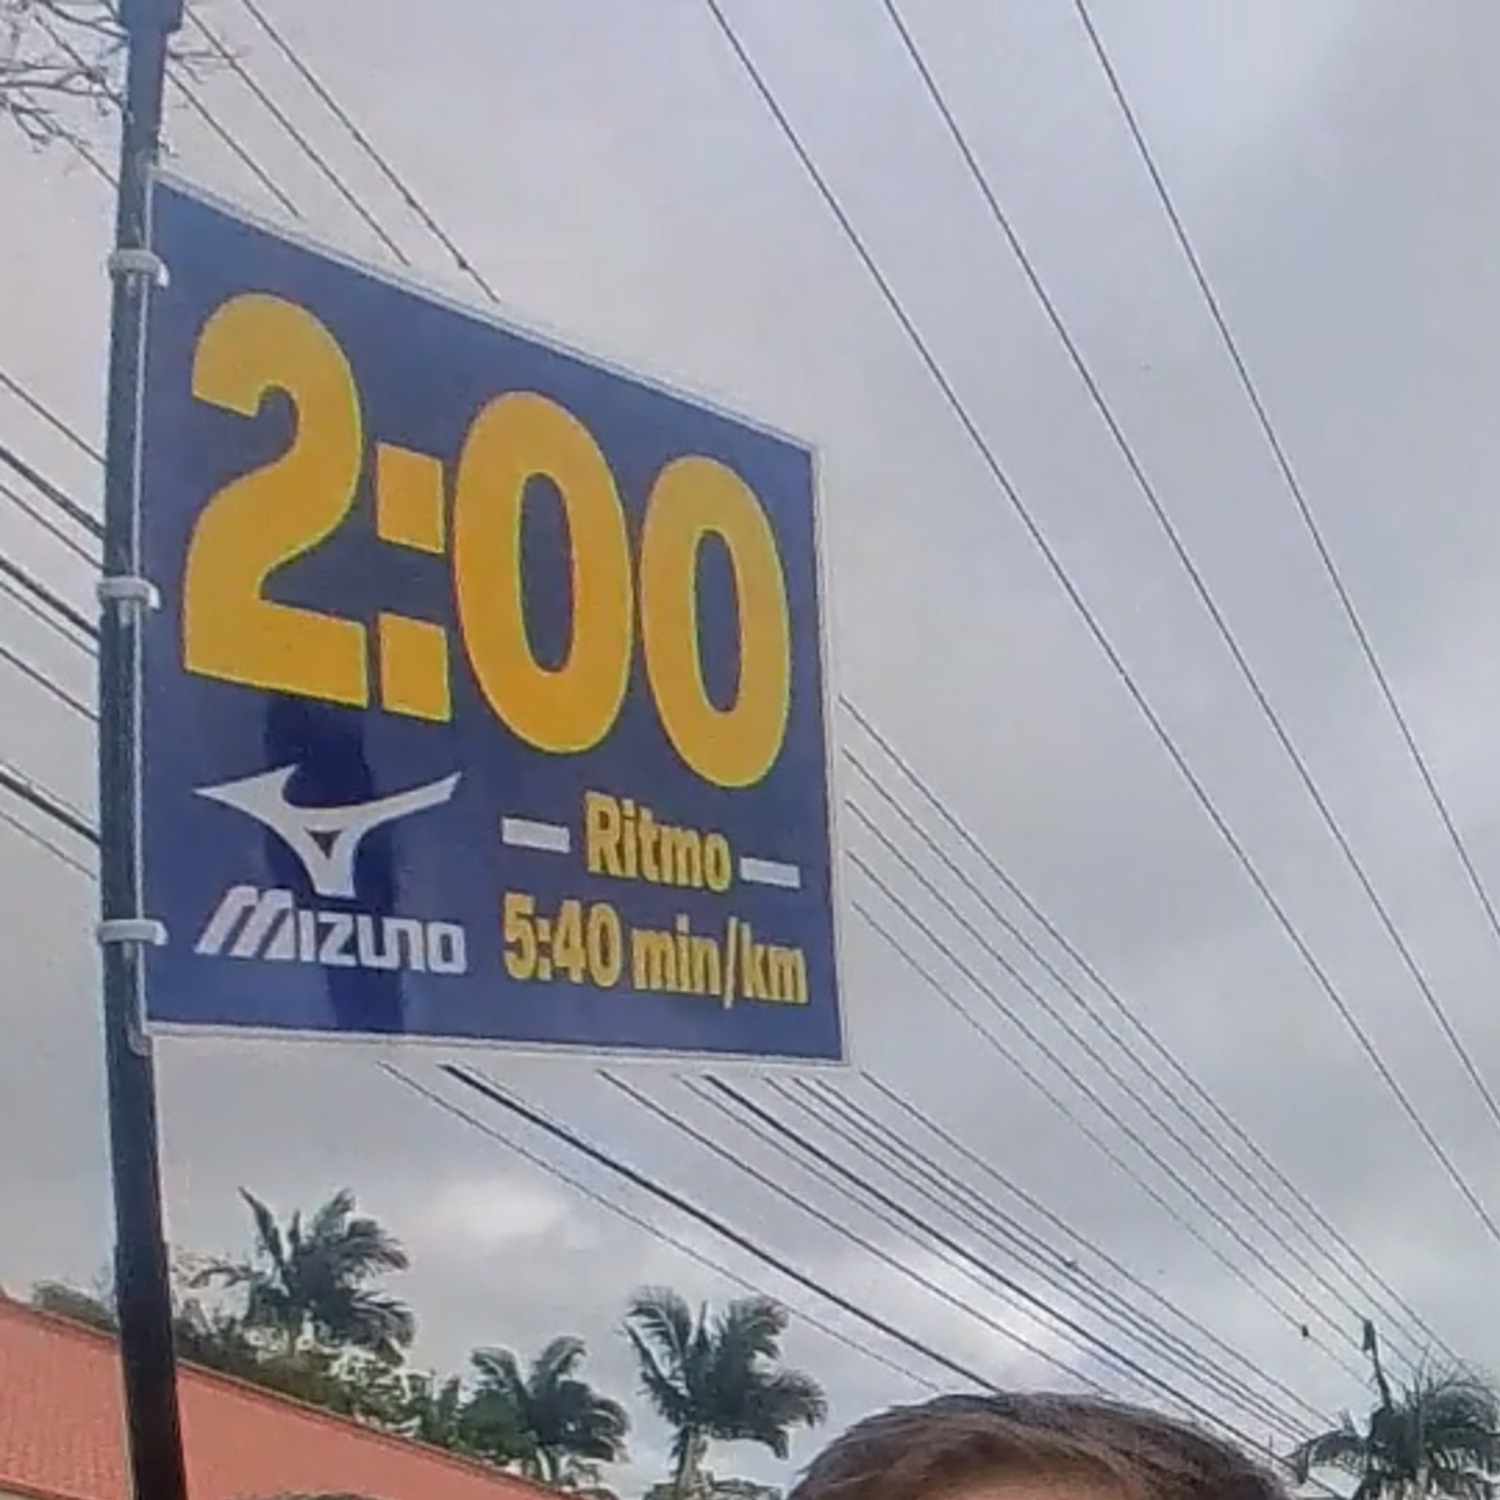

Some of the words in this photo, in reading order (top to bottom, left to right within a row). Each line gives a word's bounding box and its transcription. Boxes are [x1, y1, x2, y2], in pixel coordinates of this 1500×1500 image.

[184, 294, 791, 787] 2:00
[585, 791, 732, 891] Ritmo
[503, 893, 623, 987] 5:40
[631, 914, 808, 1009] min/km
